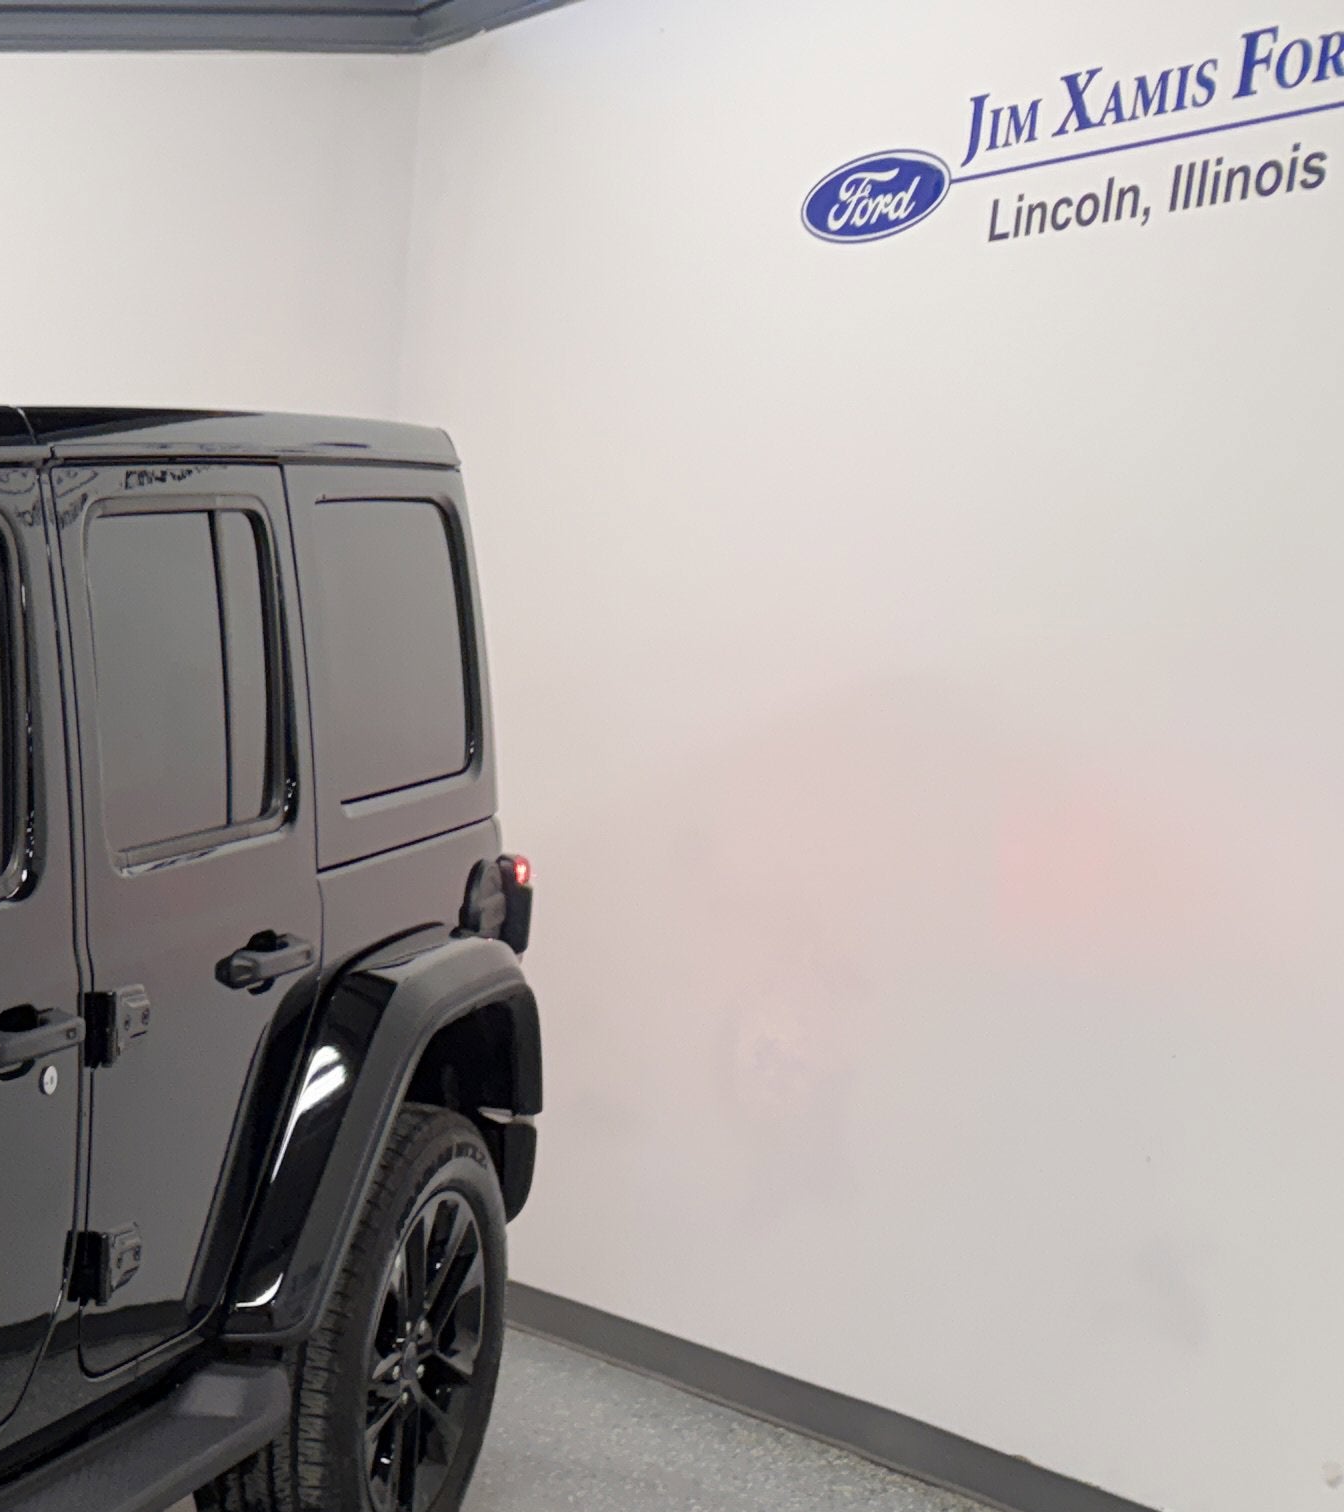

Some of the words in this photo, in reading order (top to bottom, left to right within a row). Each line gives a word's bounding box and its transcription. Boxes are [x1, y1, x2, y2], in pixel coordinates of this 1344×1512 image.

[1052, 58, 1218, 138] XAMIS
[826, 167, 921, 232] Ford
[989, 176, 1151, 243] Lincoln,
[1169, 142, 1328, 213] Illinois
